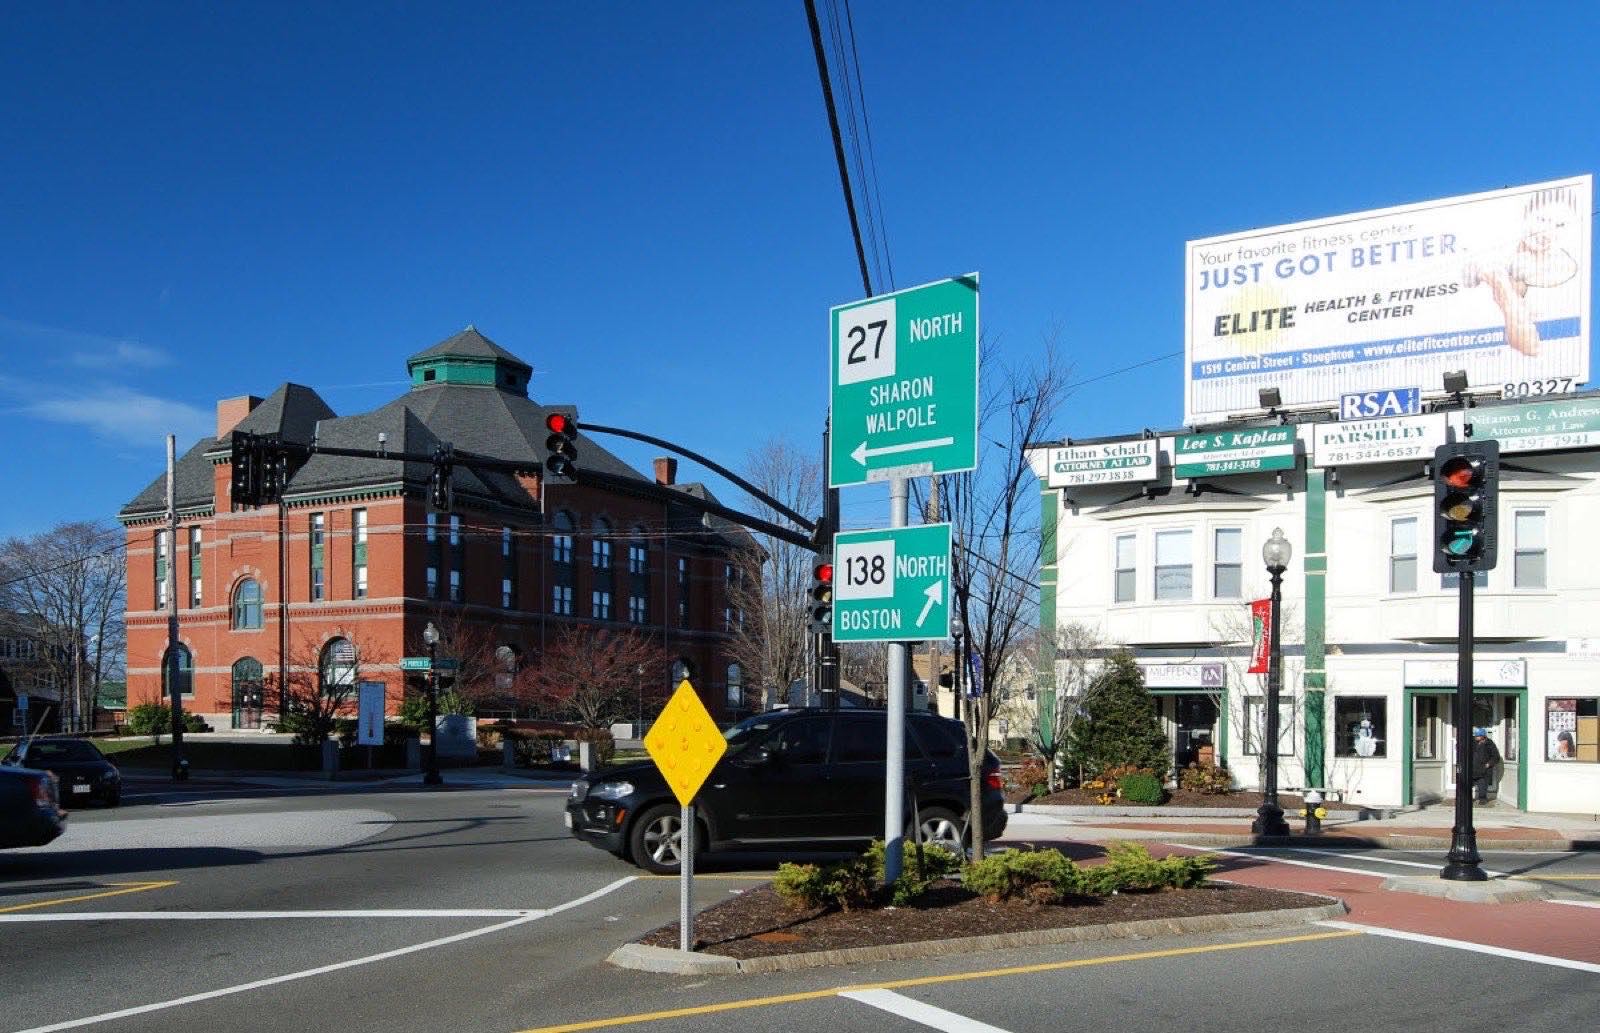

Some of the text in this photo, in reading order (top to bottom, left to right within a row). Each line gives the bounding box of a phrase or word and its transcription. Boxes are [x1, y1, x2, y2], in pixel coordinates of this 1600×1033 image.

[1199, 225, 1414, 266] Your favorite fitness center
[1199, 262, 1264, 291] JUST
[1275, 251, 1337, 279] GOT
[1304, 282, 1459, 314] HEALTH & FITNESS
[1213, 305, 1297, 337] ELITE
[1347, 304, 1415, 323] CENTER
[909, 311, 963, 343] NORTH
[846, 319, 888, 365] 27
[1225, 359, 1261, 372] Central
[1263, 355, 1293, 369] Street
[1302, 350, 1355, 366] Stoughton
[869, 376, 933, 407] SHARON
[1504, 378, 1573, 399] 80327
[1343, 391, 1404, 419] RSA
[865, 404, 937, 435] WALPOLE
[1341, 421, 1390, 432] WALTER
[1491, 425, 1541, 438] Attorney
[1562, 420, 1585, 431] Law
[1182, 430, 1288, 450] Lee S. Kaplan
[1324, 426, 1426, 446] PARSHLEY
[1056, 449, 1097, 462] Ethan
[1058, 456, 1149, 473] ATTORNEY AT LAW
[1328, 446, 1421, 462] 781-344-6537
[845, 555, 886, 587] 138
[895, 554, 947, 580] NORTH
[840, 608, 902, 631] BOSTON
